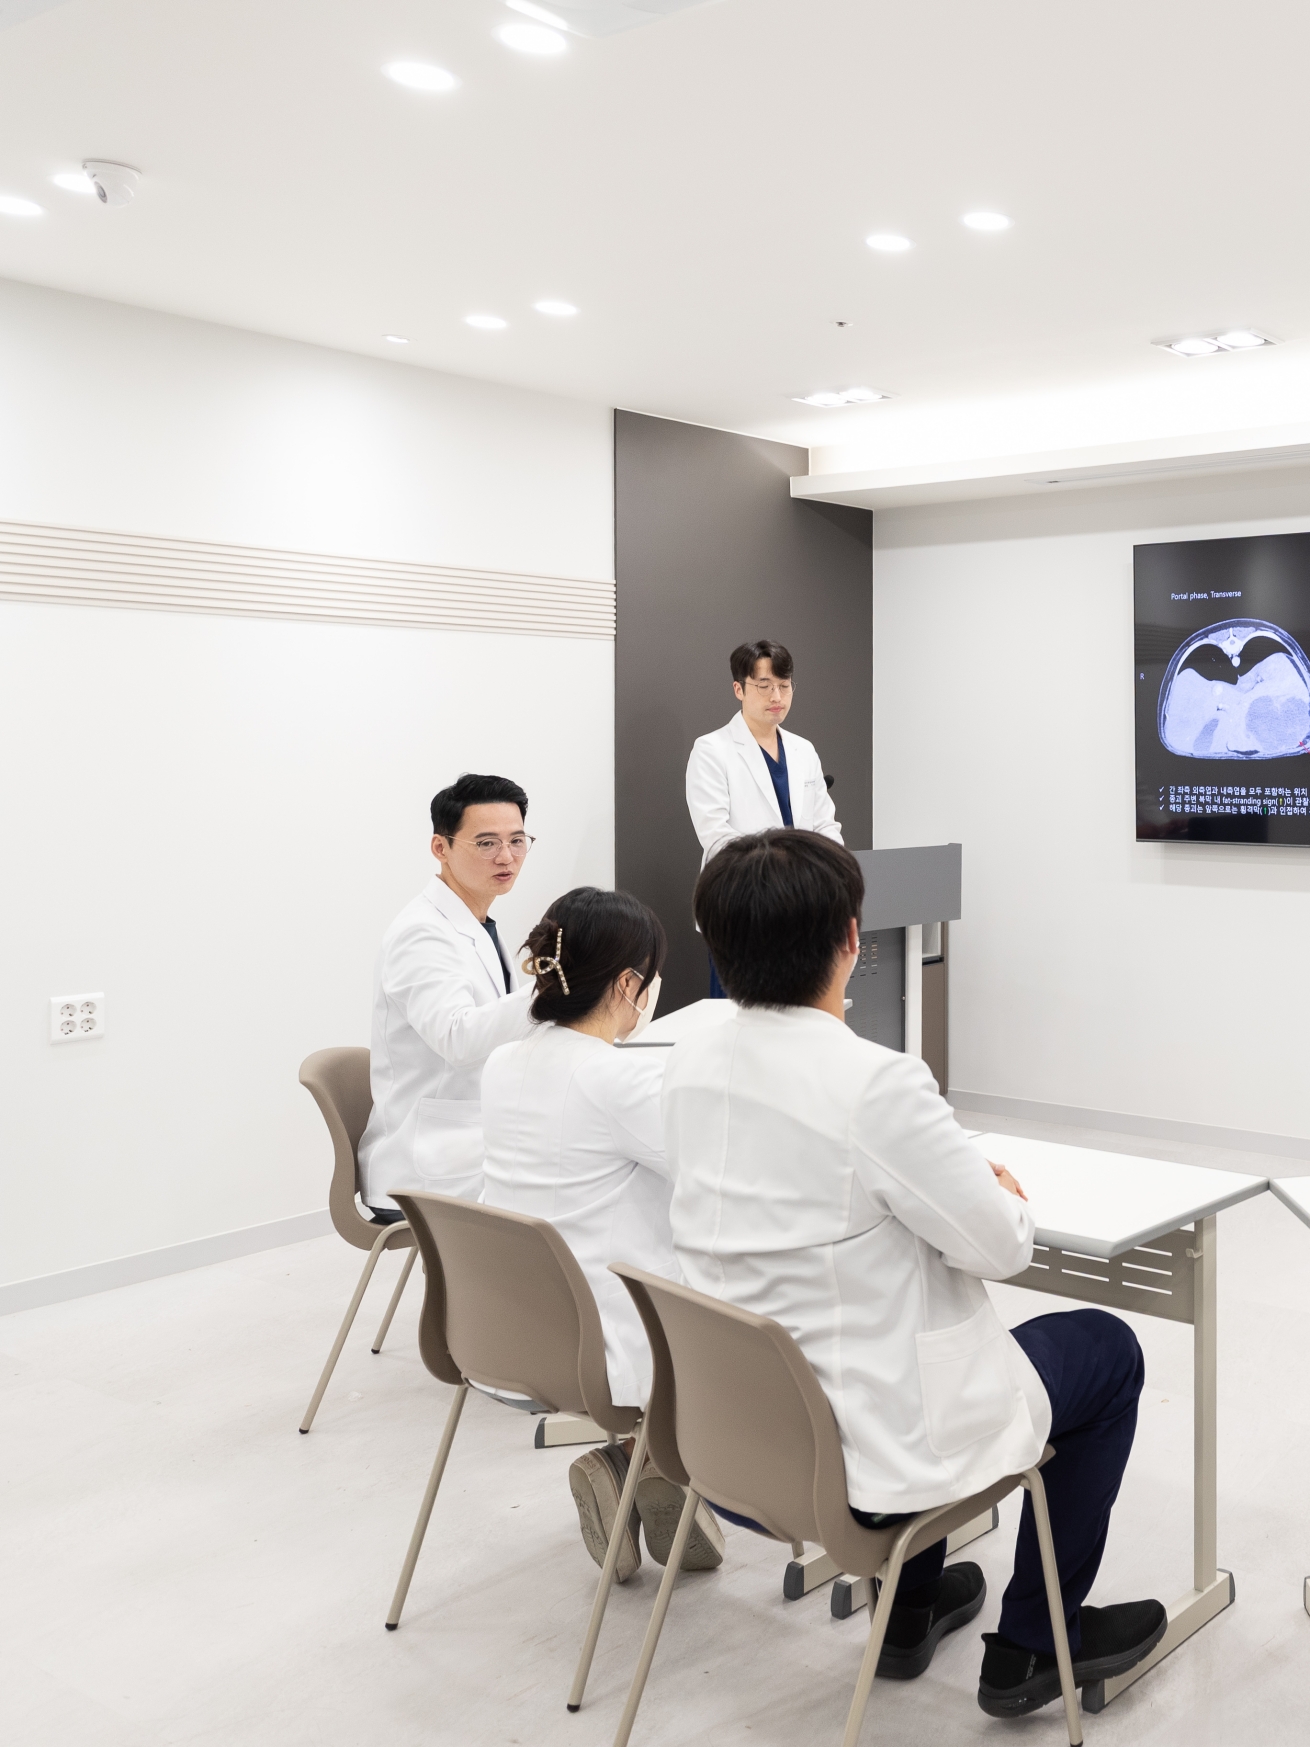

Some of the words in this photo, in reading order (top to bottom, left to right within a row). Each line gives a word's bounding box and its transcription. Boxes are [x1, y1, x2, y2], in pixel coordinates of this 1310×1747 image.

[1171, 592, 1188, 600] Portal
[1190, 592, 1208, 601] phase,
[1249, 787, 1262, 795] 모두
[1294, 788, 1308, 796] 위치
[1222, 797, 1261, 807] fat-stranding
